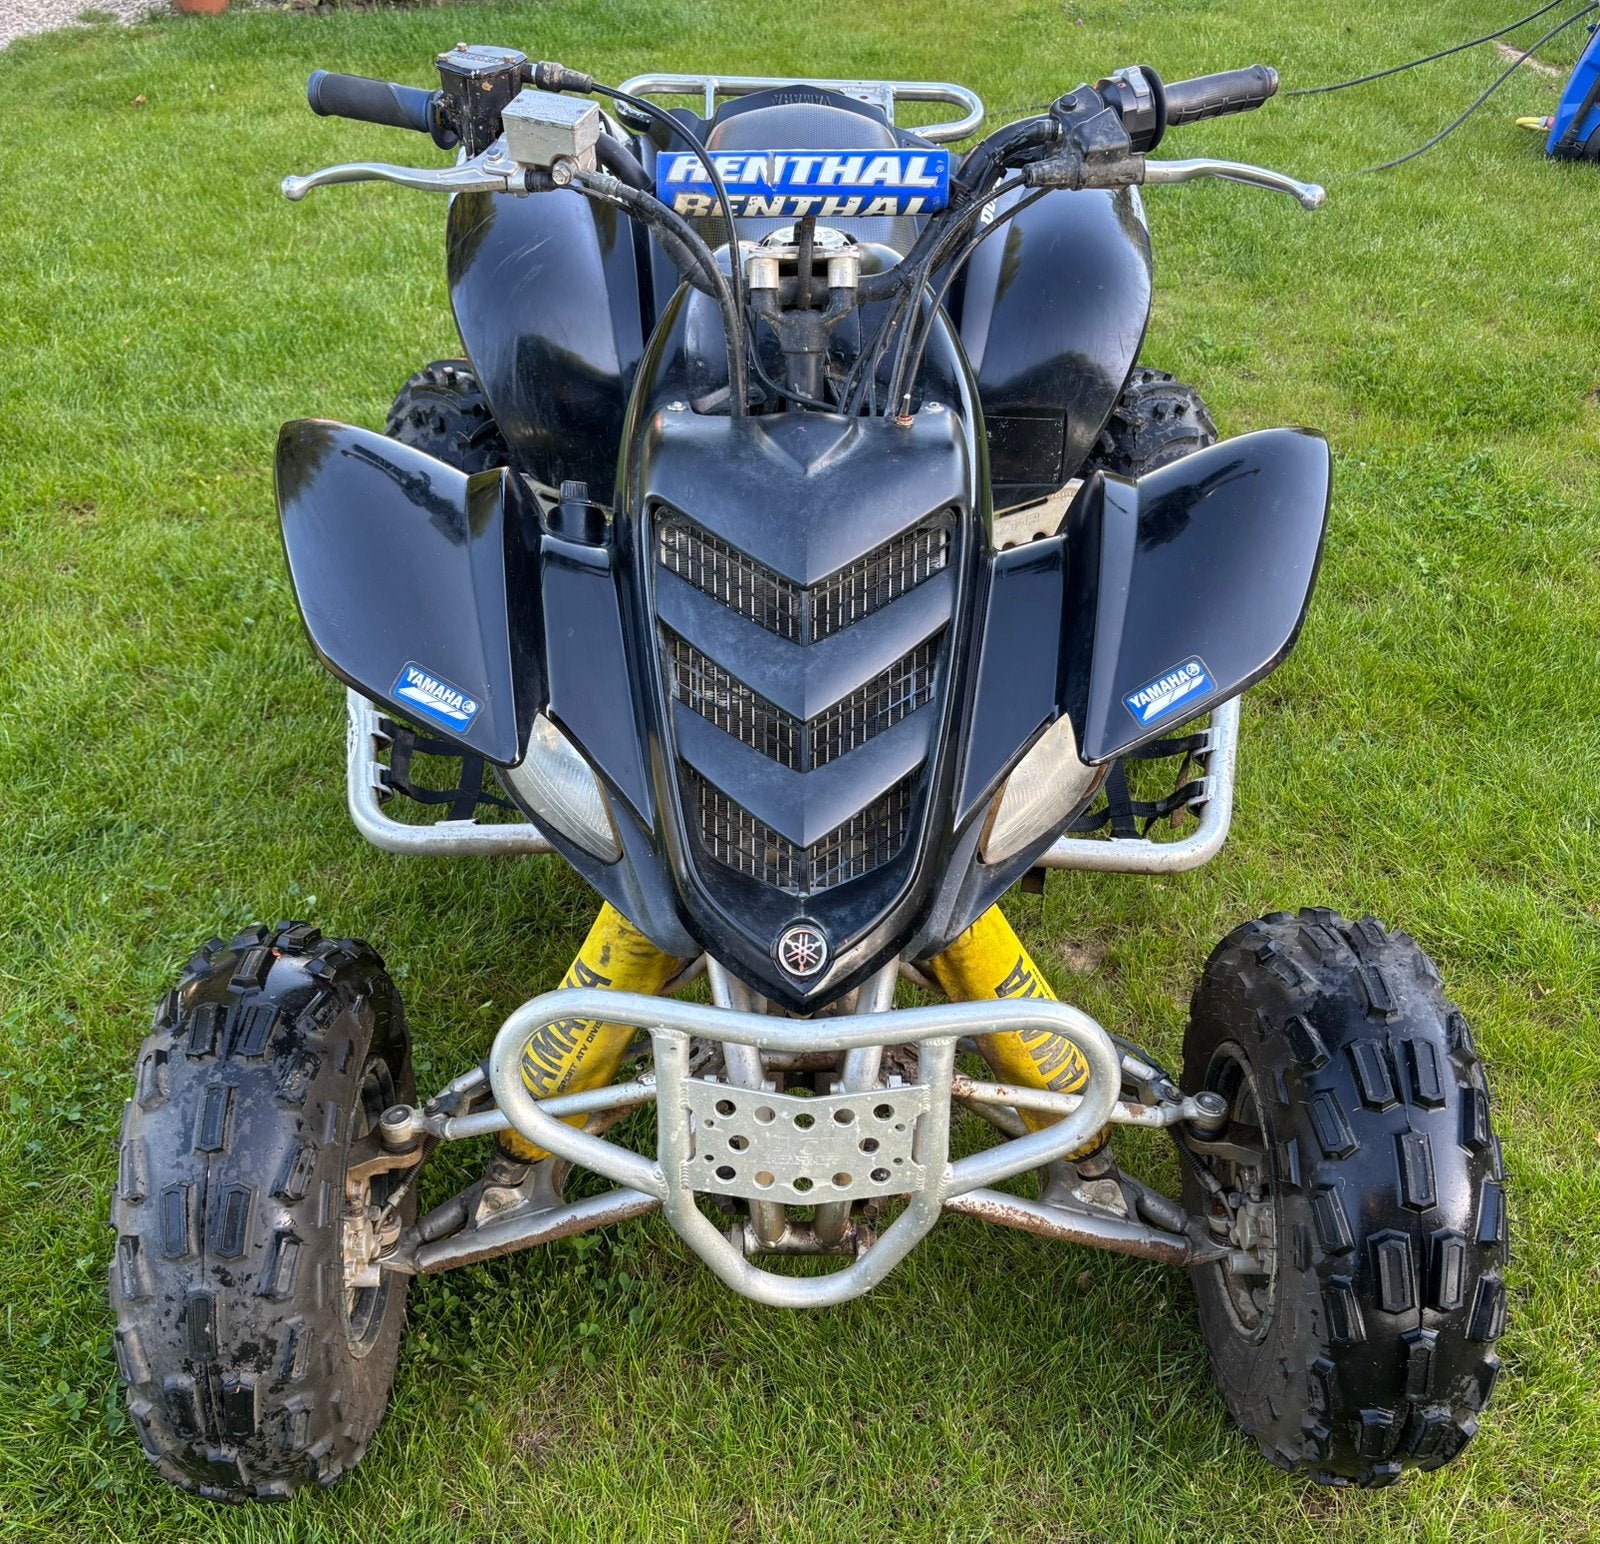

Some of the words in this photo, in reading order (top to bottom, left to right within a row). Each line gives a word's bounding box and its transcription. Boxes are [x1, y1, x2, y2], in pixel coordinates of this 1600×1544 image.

[666, 155, 938, 186] RENTHAL
[673, 193, 928, 217] RENTHAL
[406, 667, 464, 709] YAMAHA
[1128, 669, 1191, 709] YAMAHA
[520, 957, 613, 1100] AMAA
[557, 1062, 577, 1093] SPORT
[576, 1043, 588, 1061] ATV
[586, 1019, 603, 1043] DIVIS
